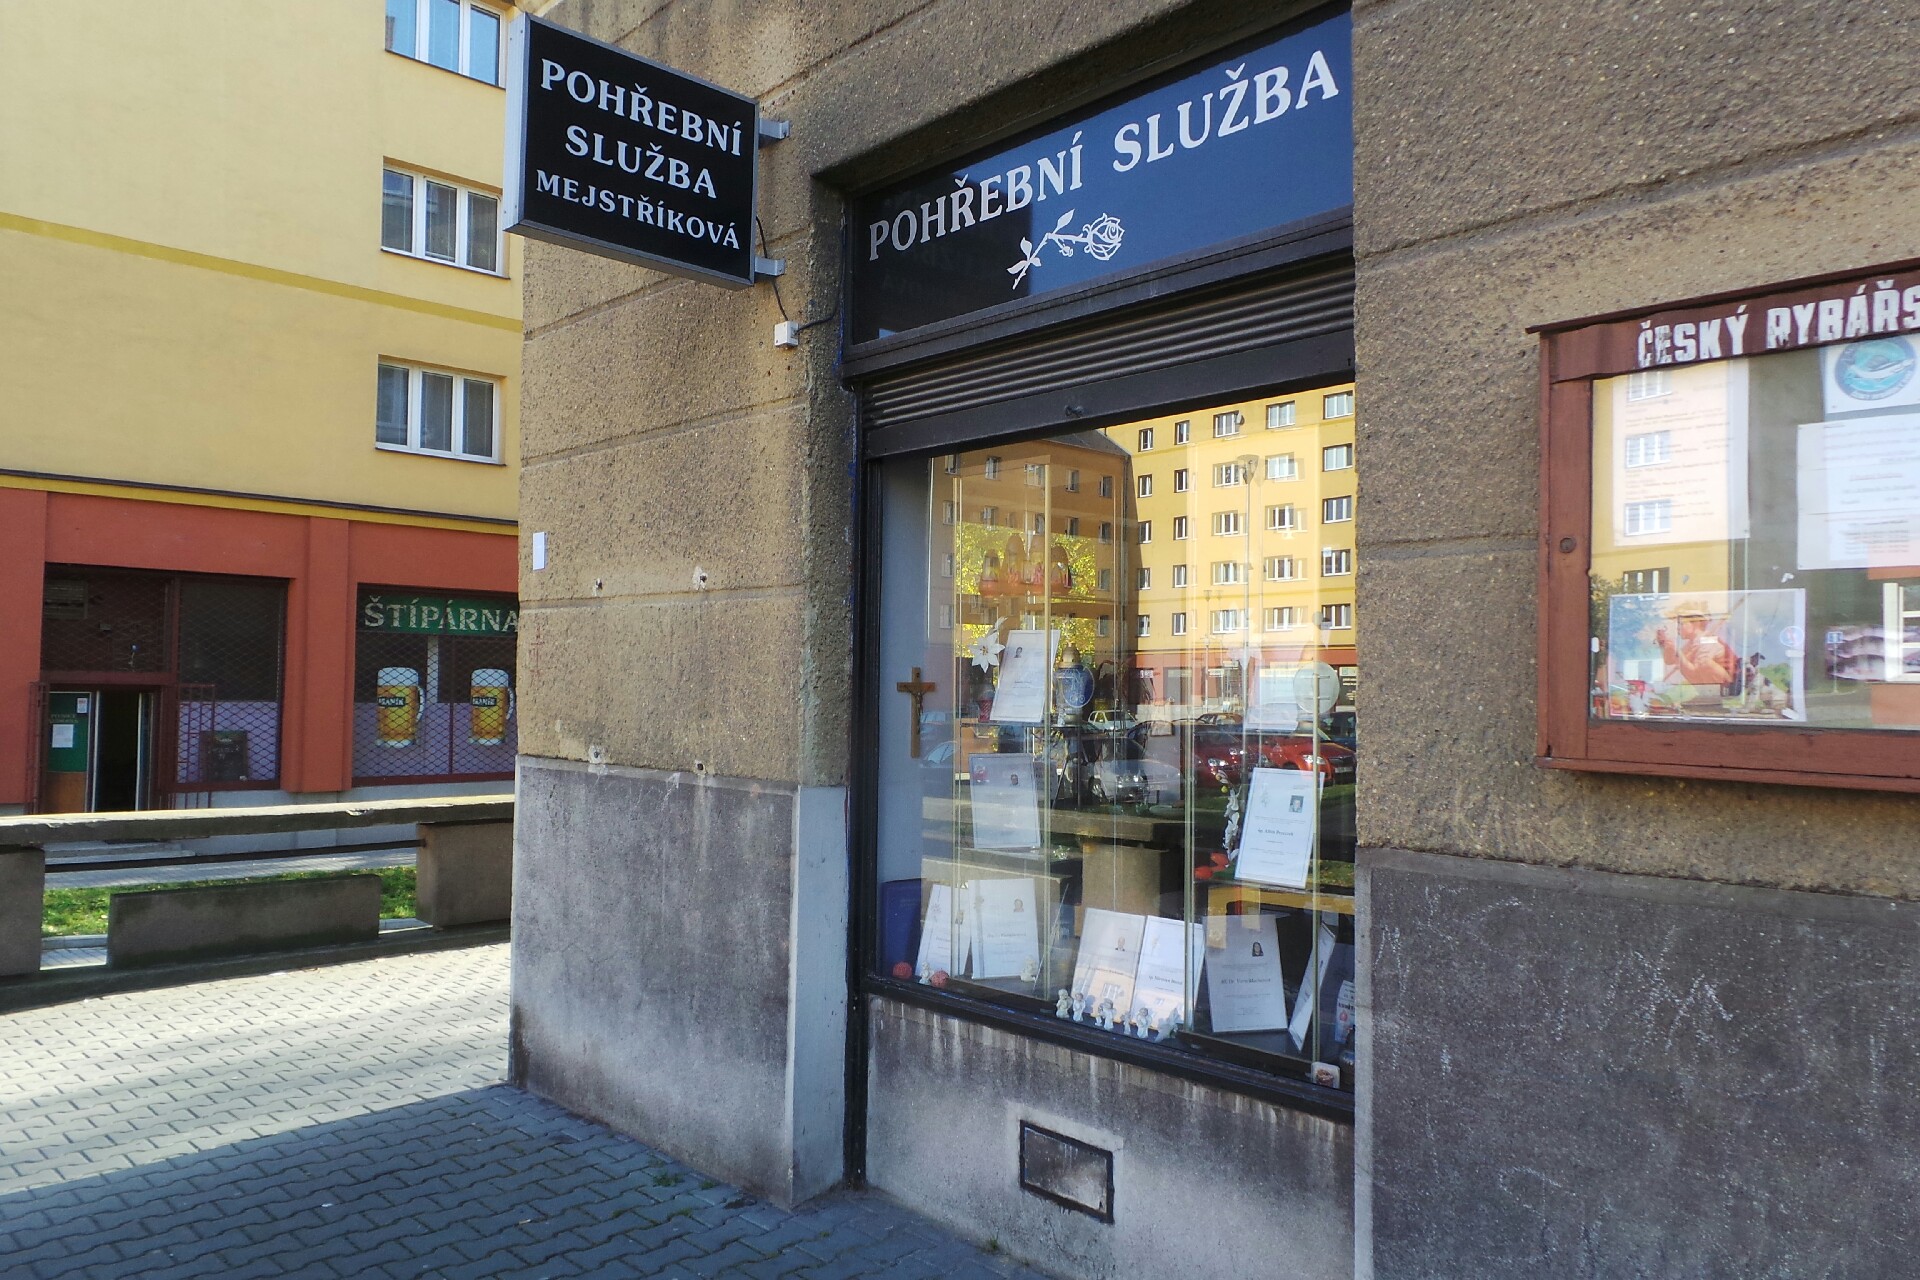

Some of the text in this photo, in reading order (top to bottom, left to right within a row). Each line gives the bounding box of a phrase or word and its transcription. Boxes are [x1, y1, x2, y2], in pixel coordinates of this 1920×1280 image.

[540, 58, 743, 156] POHŘEBNÍ
[565, 125, 717, 199] SLUŽBA
[869, 49, 1340, 262] POHŘEBNÍ SLUŽBA
[535, 169, 740, 250] MEJSTŘÍKOVÁ
[1637, 304, 1749, 369] ČESKÝ
[364, 595, 518, 633] ŠTÍPÁRNA
